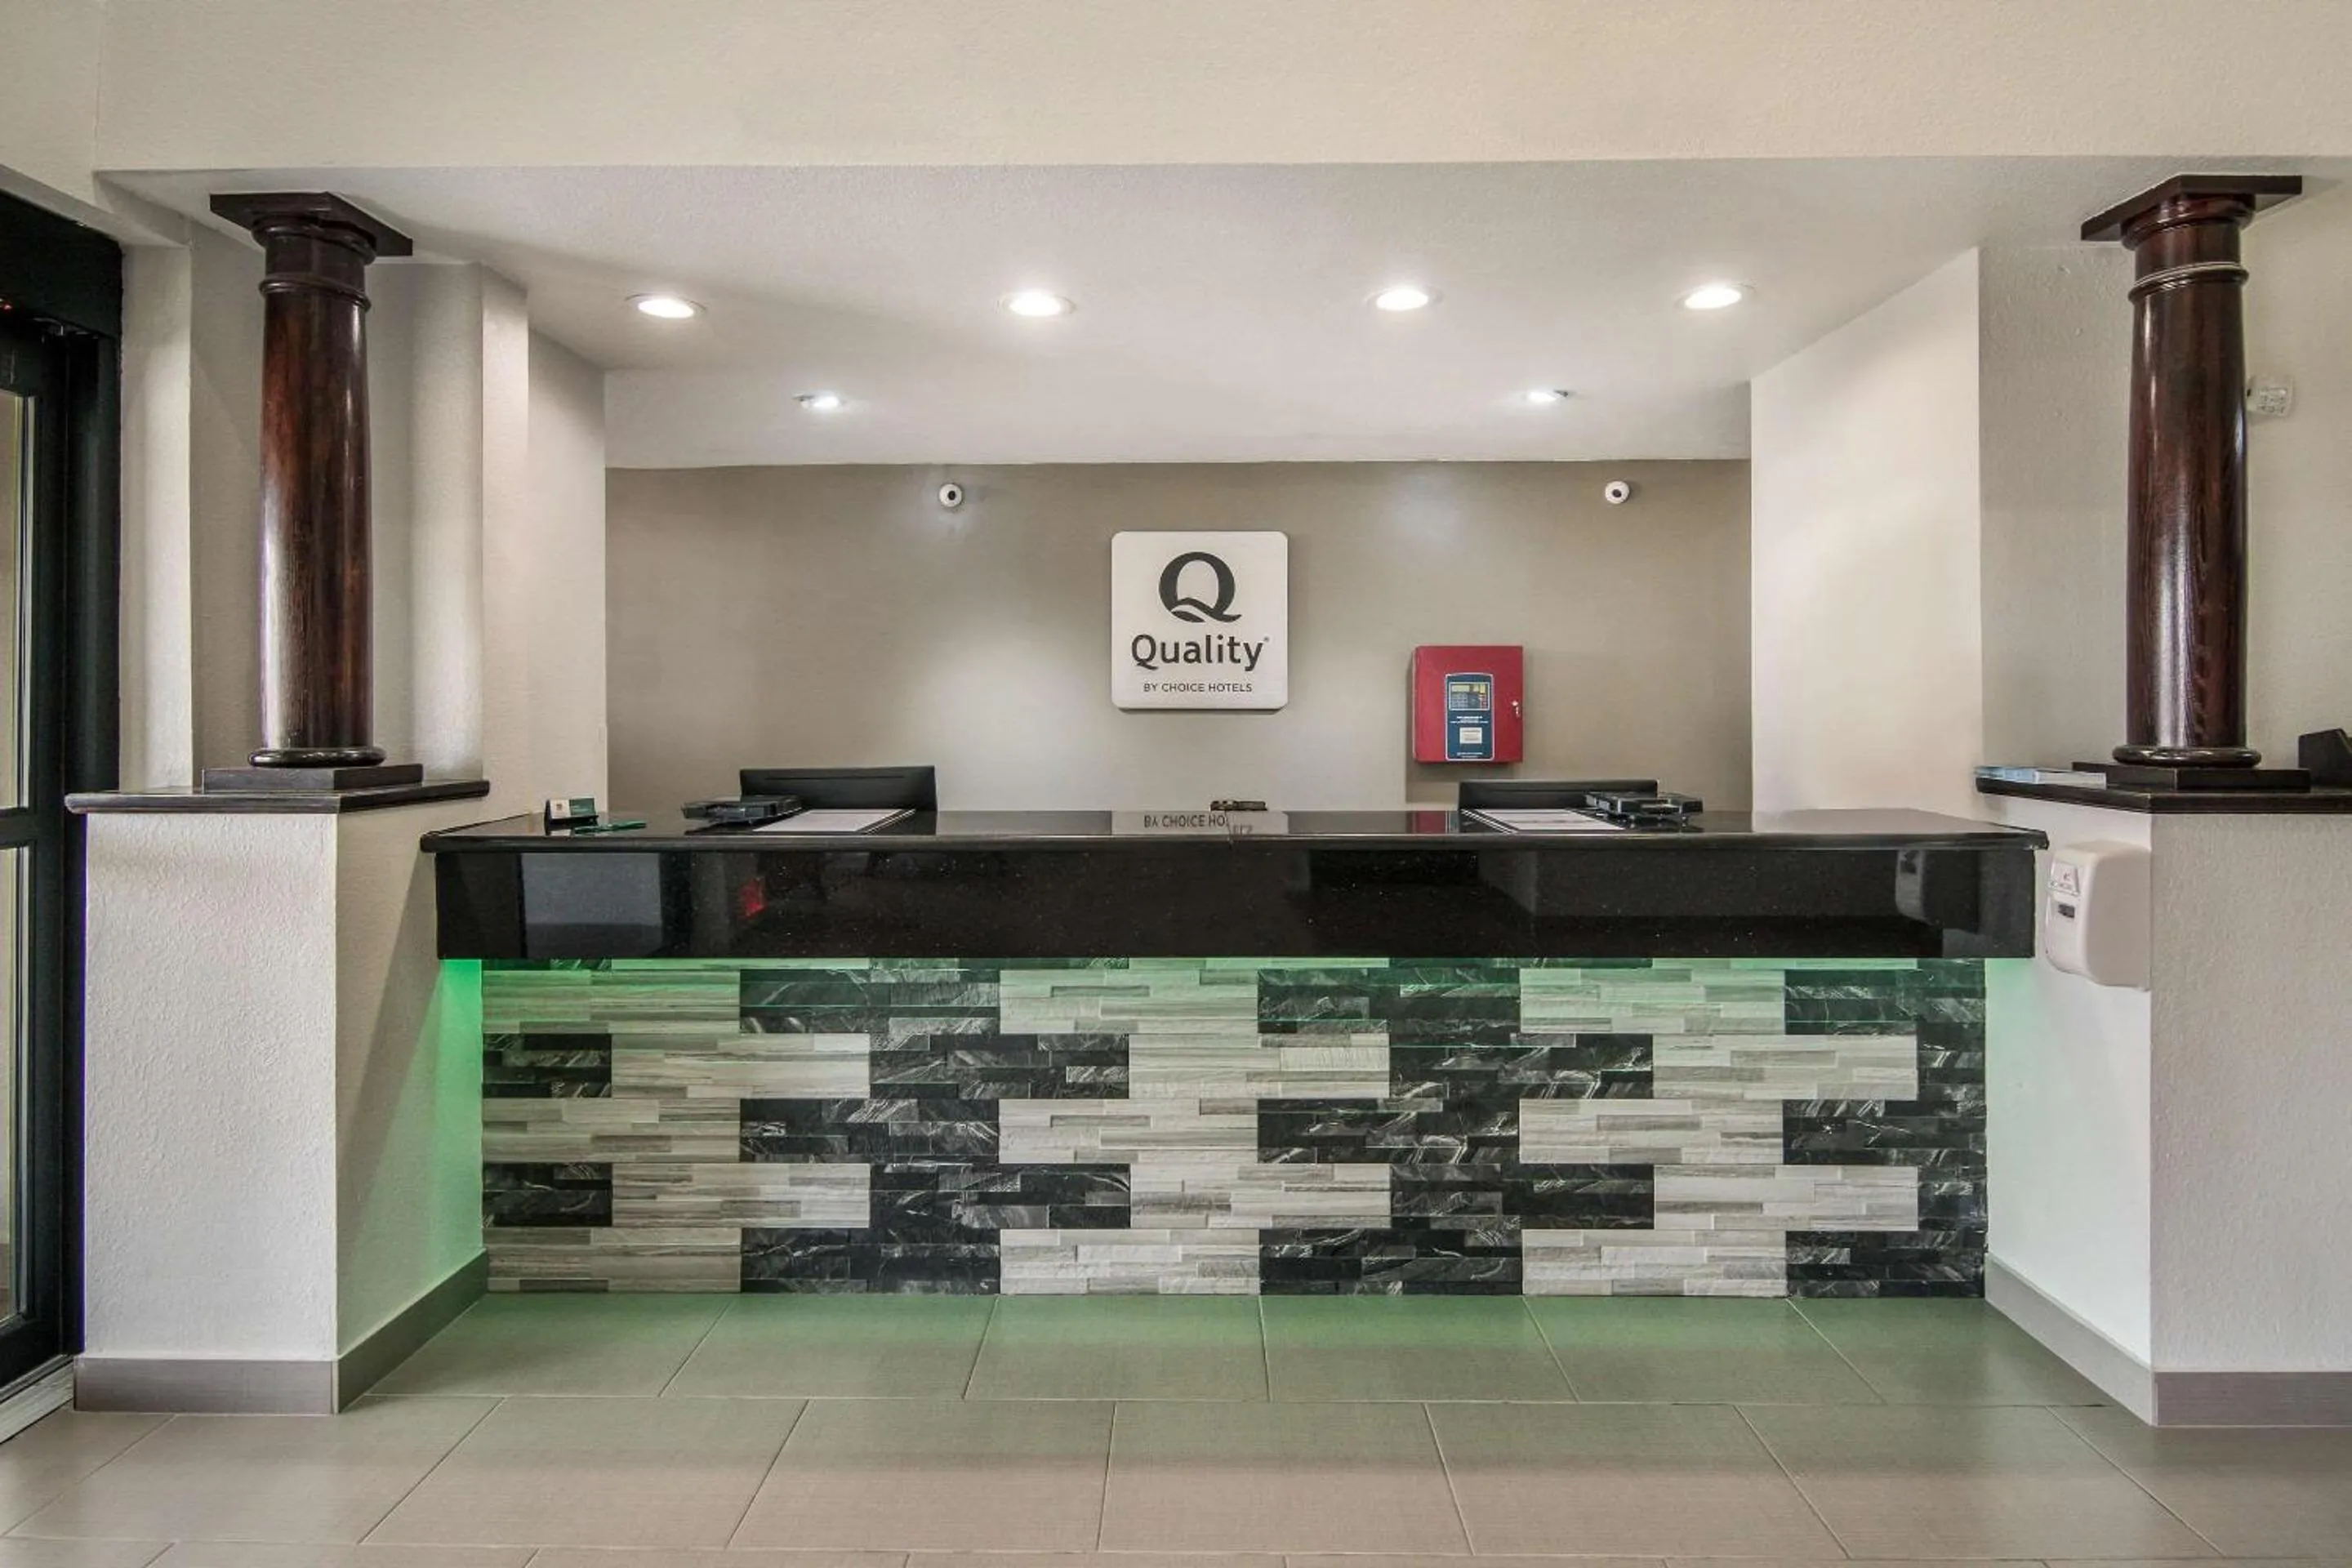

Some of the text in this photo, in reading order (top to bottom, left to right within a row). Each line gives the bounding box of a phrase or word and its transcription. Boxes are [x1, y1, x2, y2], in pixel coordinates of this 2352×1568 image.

[1159, 551, 1242, 623] Q
[1131, 634, 1263, 671] Quality
[1143, 683, 1252, 693] BY CHOICE HOTELS
